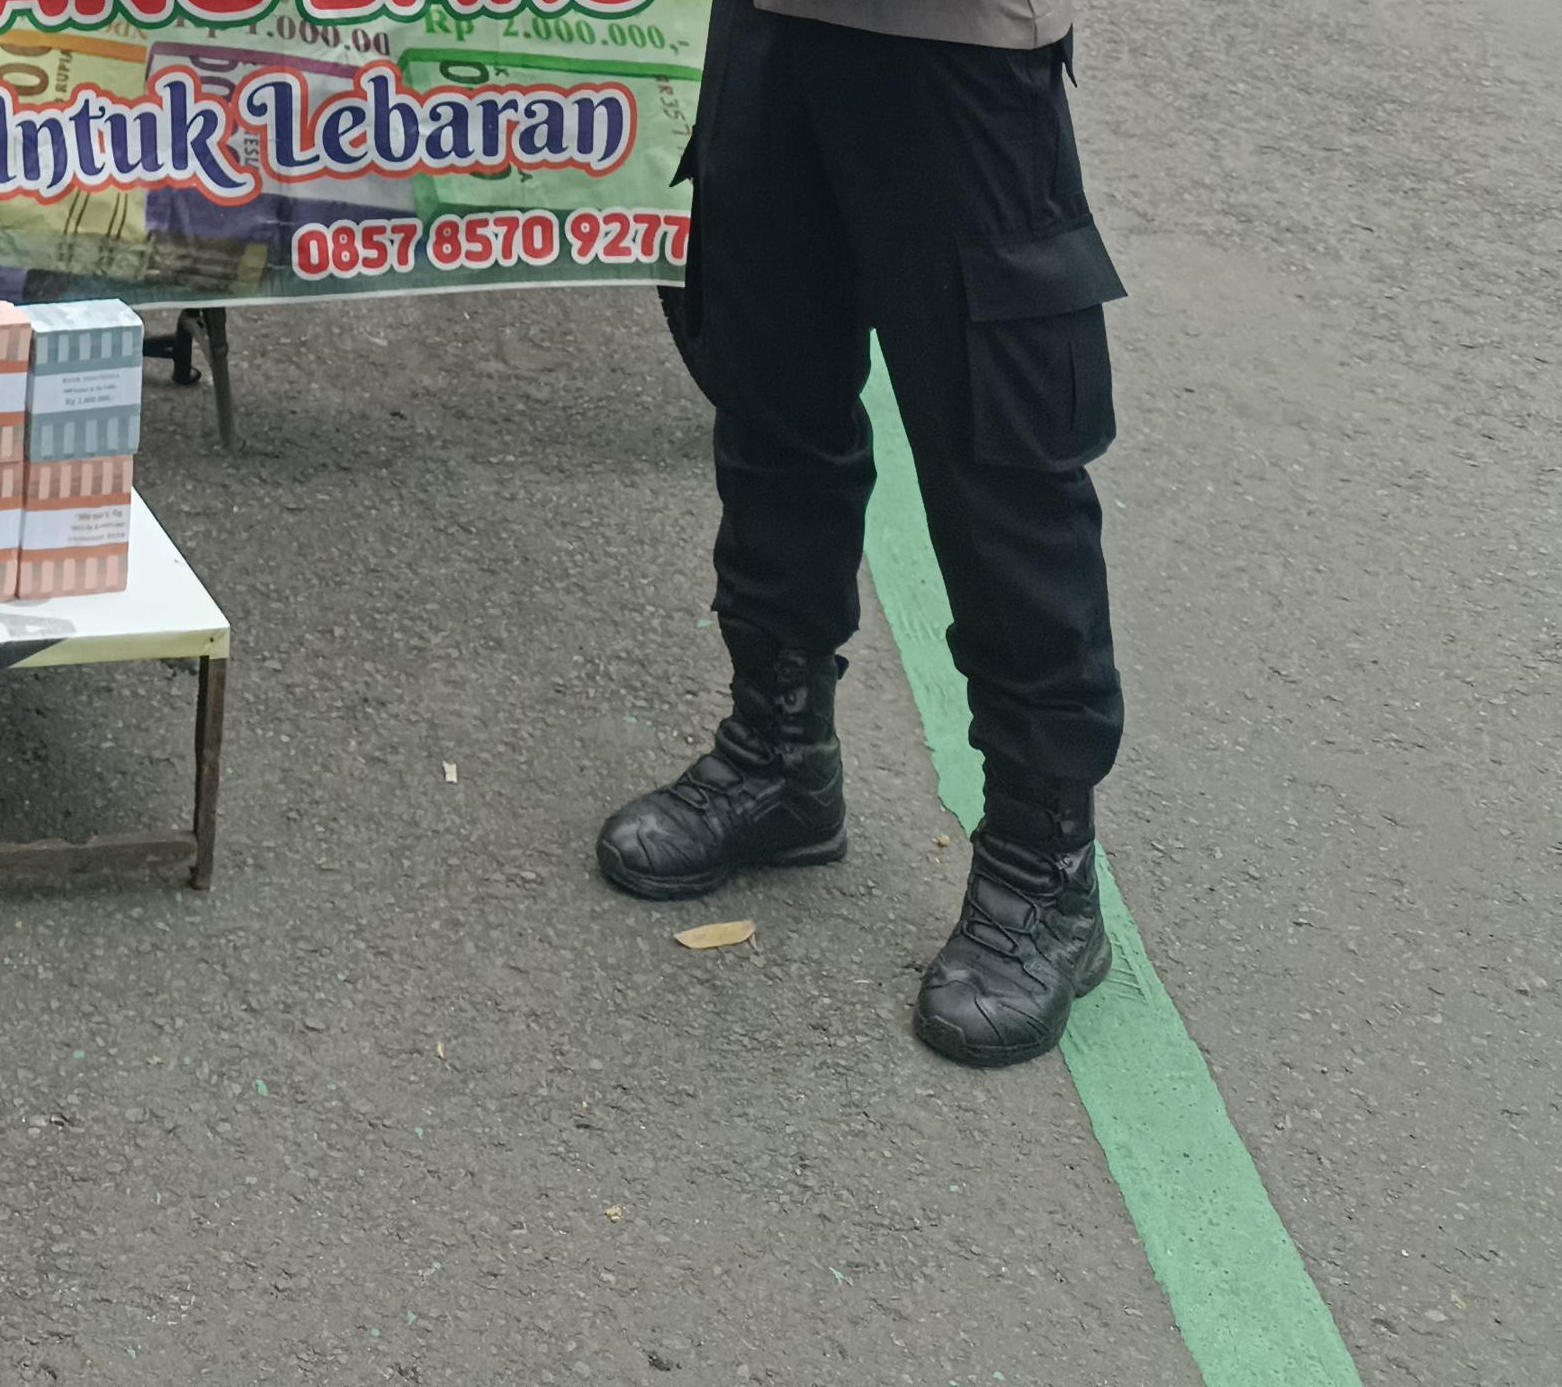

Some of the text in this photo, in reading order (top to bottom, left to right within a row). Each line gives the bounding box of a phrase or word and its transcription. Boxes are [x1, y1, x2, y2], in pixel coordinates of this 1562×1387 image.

[246, 74, 625, 169] Lebaran
[296, 213, 691, 275] 0857 8570 9277
